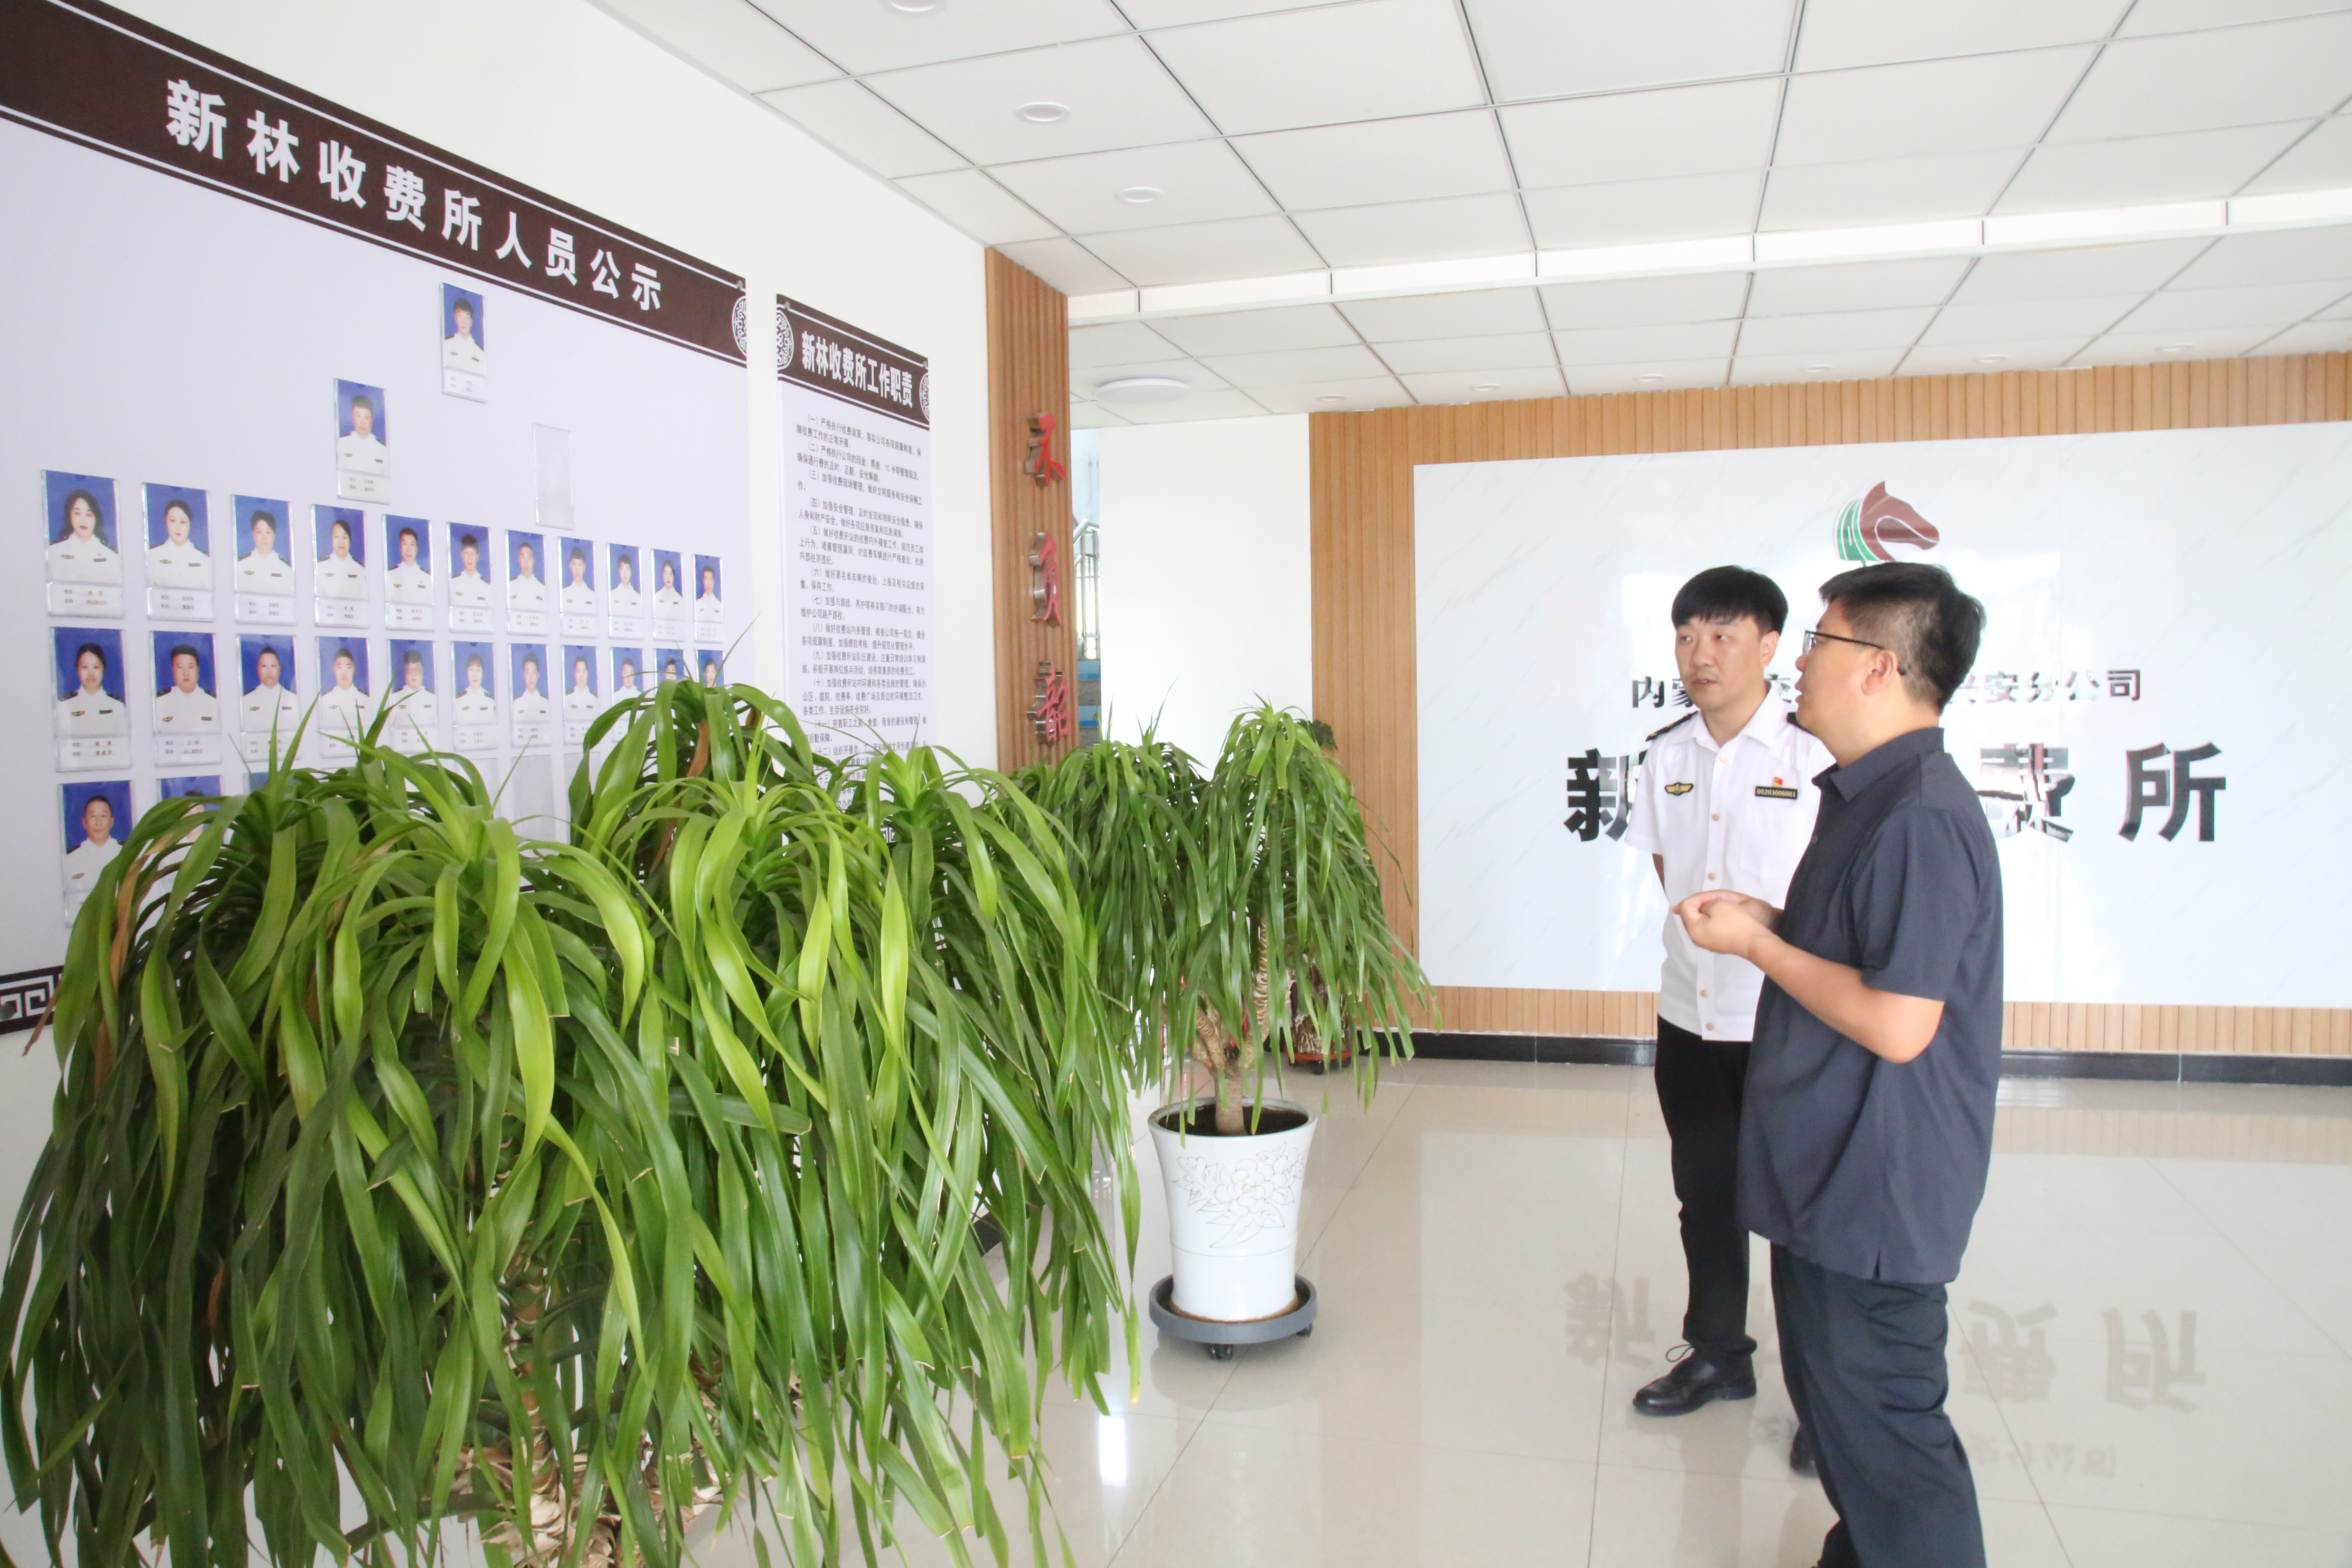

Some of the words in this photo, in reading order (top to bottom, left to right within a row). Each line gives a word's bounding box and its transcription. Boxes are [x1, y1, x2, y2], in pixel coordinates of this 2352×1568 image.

[166, 79, 662, 312] 新林收费所人员公示
[802, 331, 913, 408] 新林收费所工作职责
